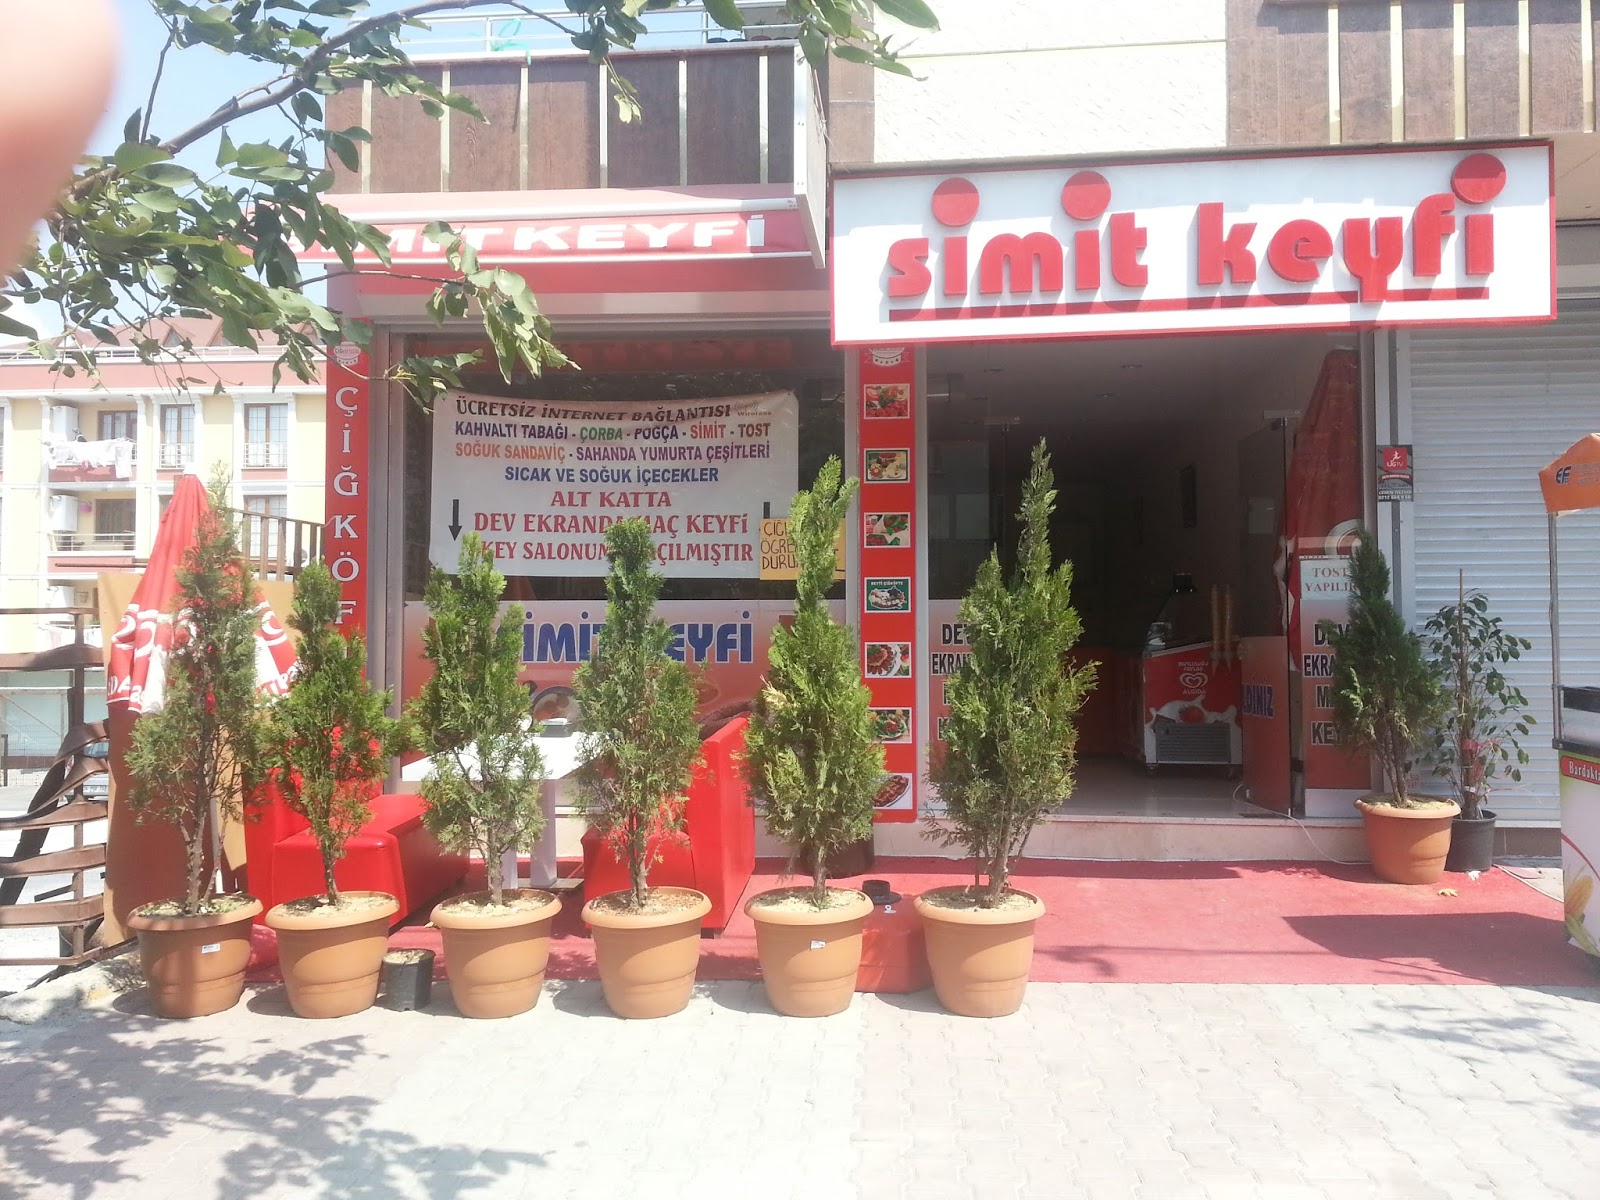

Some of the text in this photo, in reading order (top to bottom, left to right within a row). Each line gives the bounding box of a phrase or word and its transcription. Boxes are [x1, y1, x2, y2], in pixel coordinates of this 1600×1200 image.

[888, 153, 1506, 302] simit keyfi
[456, 395, 731, 423] ÜCRETSİZ İNTERNET BAĞLANTISI
[455, 420, 517, 438] KAHVALTI
[521, 422, 568, 440] TABAĞI
[580, 426, 623, 443] ÇORBA
[690, 421, 726, 439] SİMİT
[737, 422, 771, 438] TOST
[455, 440, 501, 458] SOĞUK
[504, 442, 566, 464] SANDAVİÇ
[576, 446, 636, 461] SAHANDA
[640, 445, 703, 461] YUMURTA
[706, 440, 771, 463] ÇEŞİTLERİ
[504, 465, 719, 486] SICAK VE SOĞUK İÇECEKLER
[330, 386, 360, 625] ÇİĞKÖF
[550, 490, 672, 508] ALT KATTA
[474, 512, 517, 532] DEV
[643, 515, 679, 539] AÇ
[686, 513, 748, 534] KEYFİ
[481, 540, 754, 566] KEY SALONU ÇILMIŞTIR
[1312, 567, 1349, 578] TOST
[662, 610, 754, 664] EYFİ
